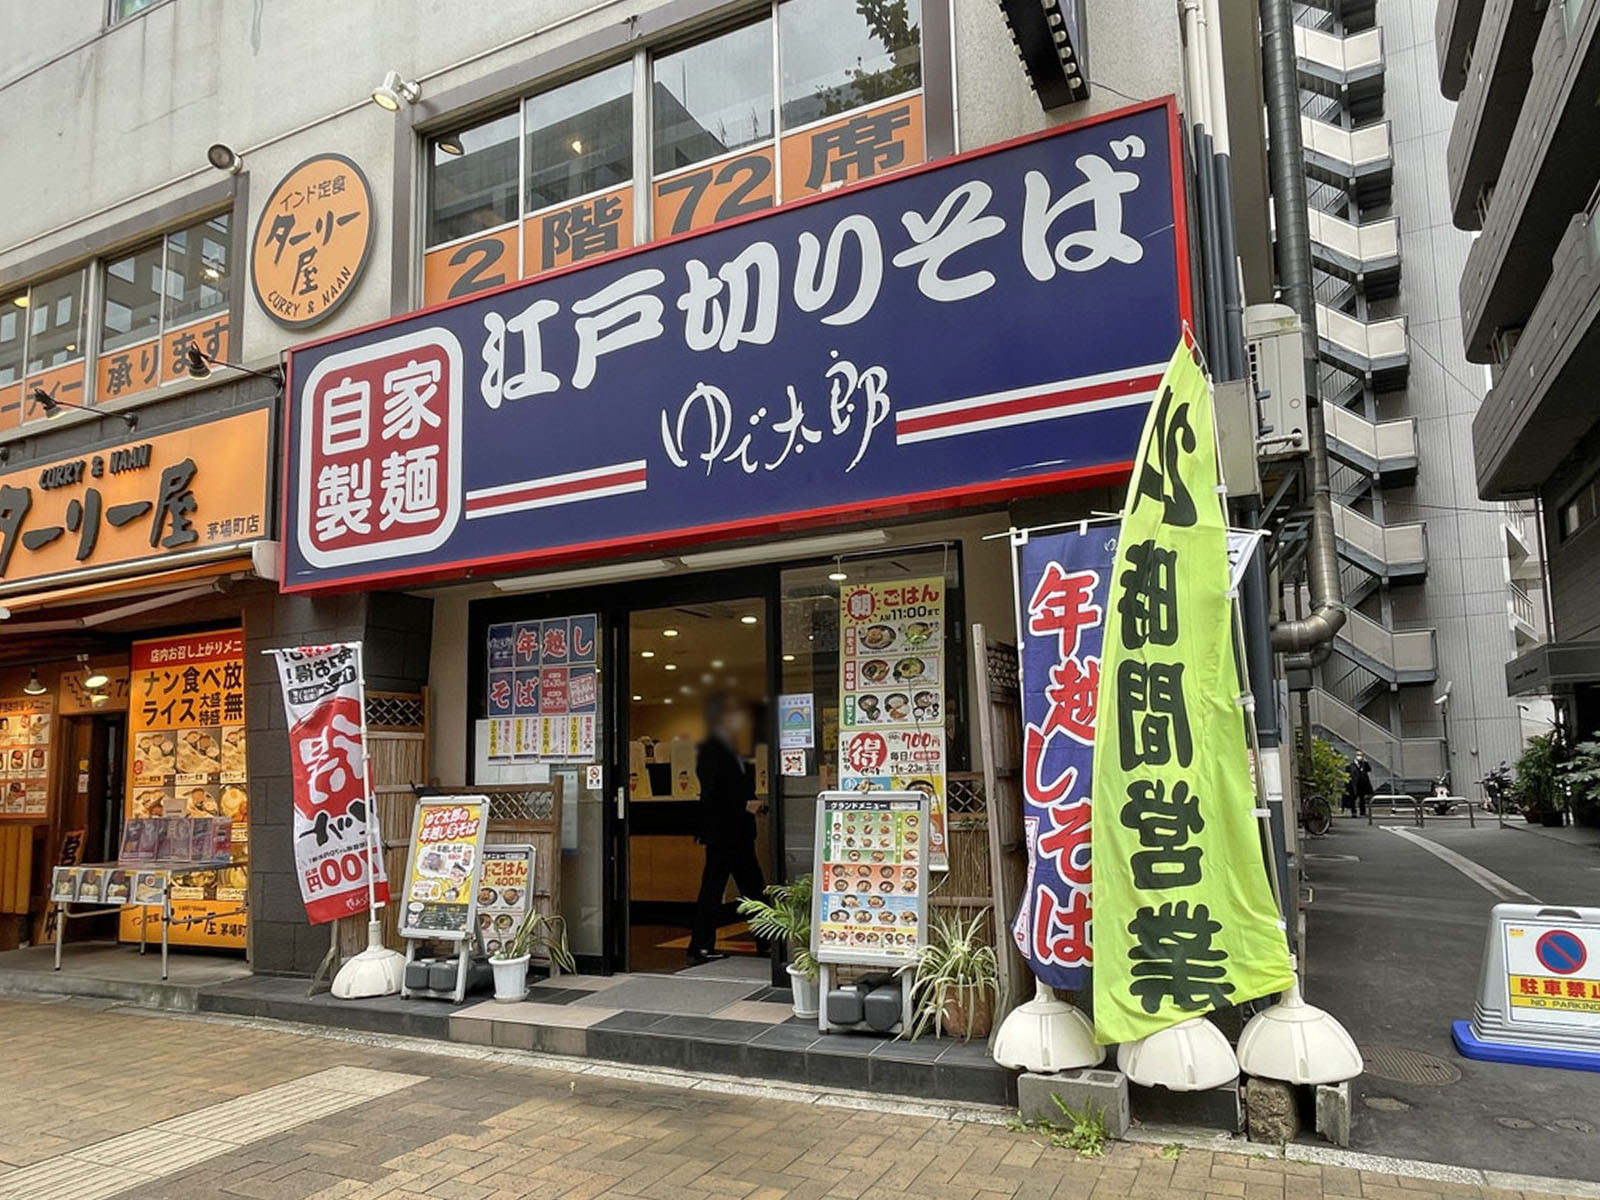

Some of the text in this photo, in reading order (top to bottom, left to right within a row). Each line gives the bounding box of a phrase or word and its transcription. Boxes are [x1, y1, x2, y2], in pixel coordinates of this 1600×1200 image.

[280, 175, 347, 210] インド定食
[480, 135, 1146, 409] 江戸切りそば
[267, 290, 301, 317] CURRY
[322, 267, 352, 307] NAAN
[661, 350, 893, 475] ゆで太郎
[39, 459, 85, 490] CURRY
[109, 444, 153, 476] NAAN
[0, 457, 199, 578] ターリー屋
[207, 514, 260, 540] 茅場町店
[144, 661, 242, 697] ナン食べ放
[142, 698, 196, 726] ライス
[831, 802, 887, 811] グランドメニュー
[1530, 999, 1547, 1007] NO
